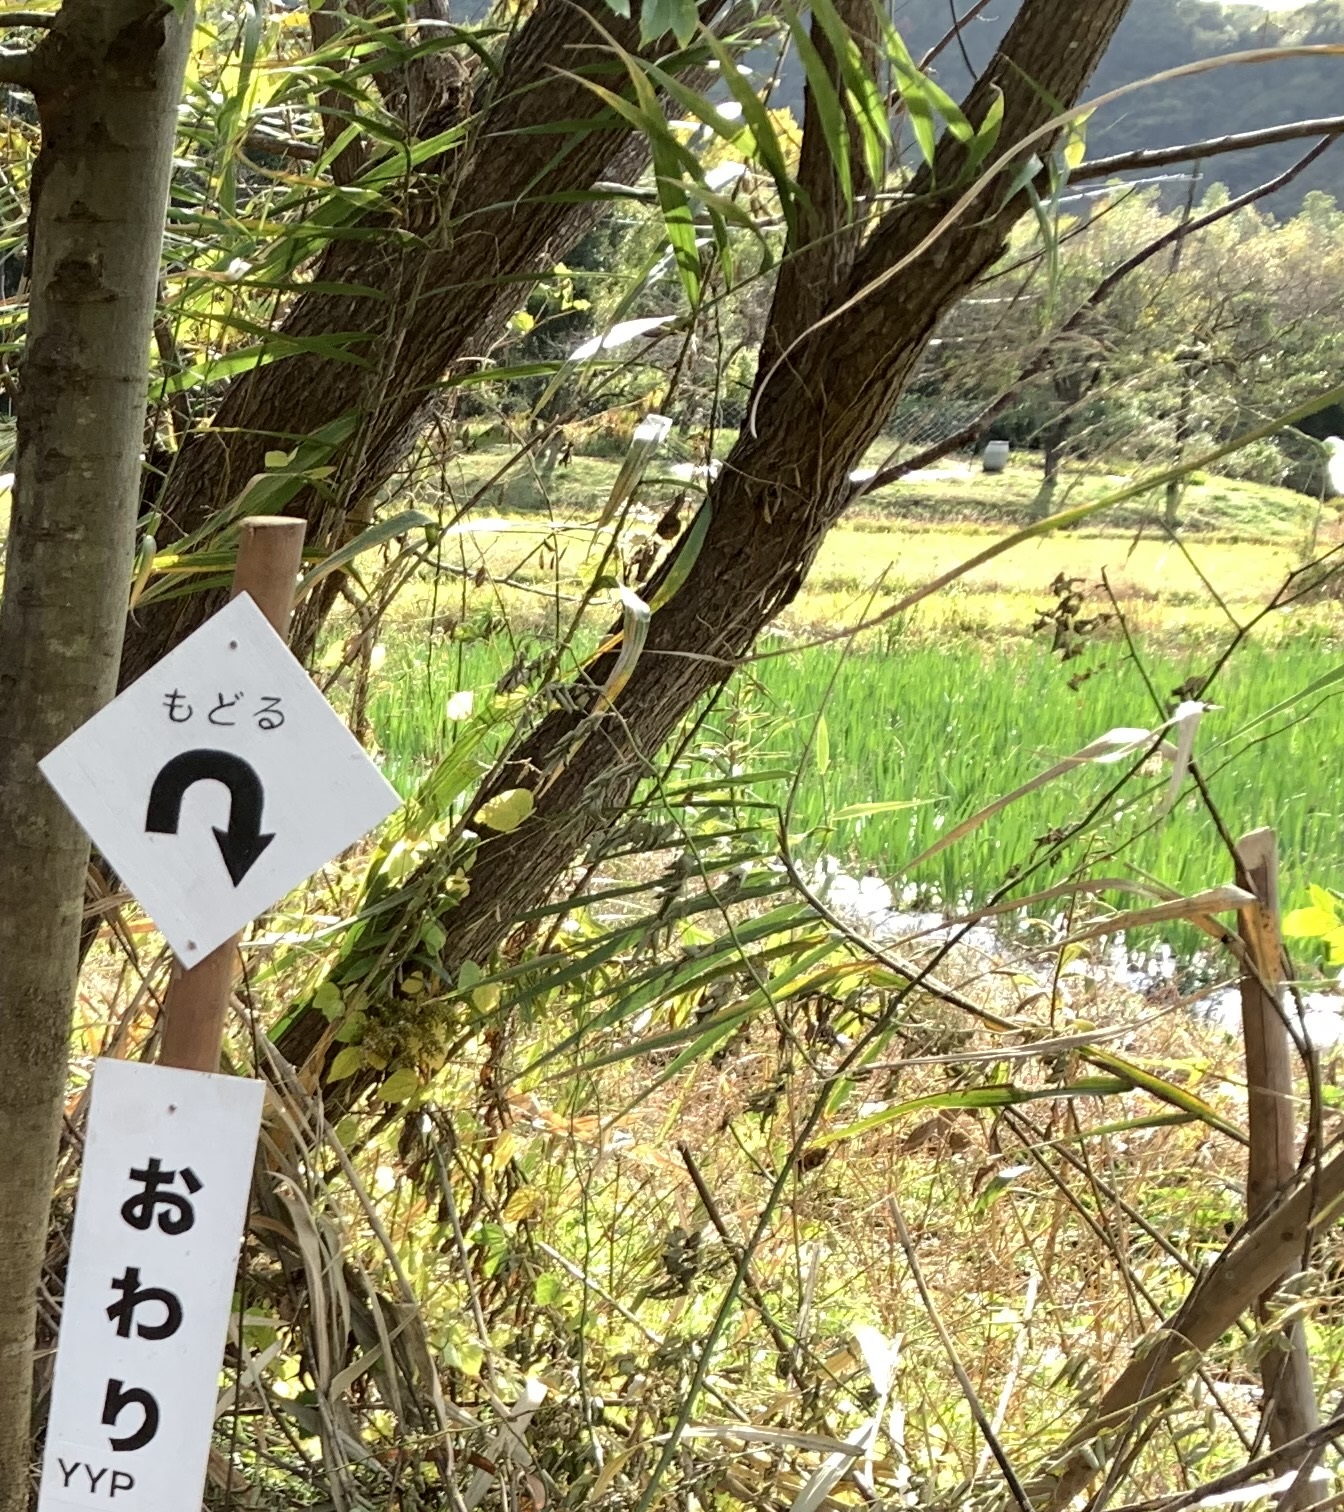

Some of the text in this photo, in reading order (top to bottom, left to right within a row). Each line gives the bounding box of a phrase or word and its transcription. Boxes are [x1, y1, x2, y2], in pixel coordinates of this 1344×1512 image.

[162, 687, 286, 731] もどる
[100, 1156, 206, 1453] おわり
[56, 1457, 136, 1498] YYP
